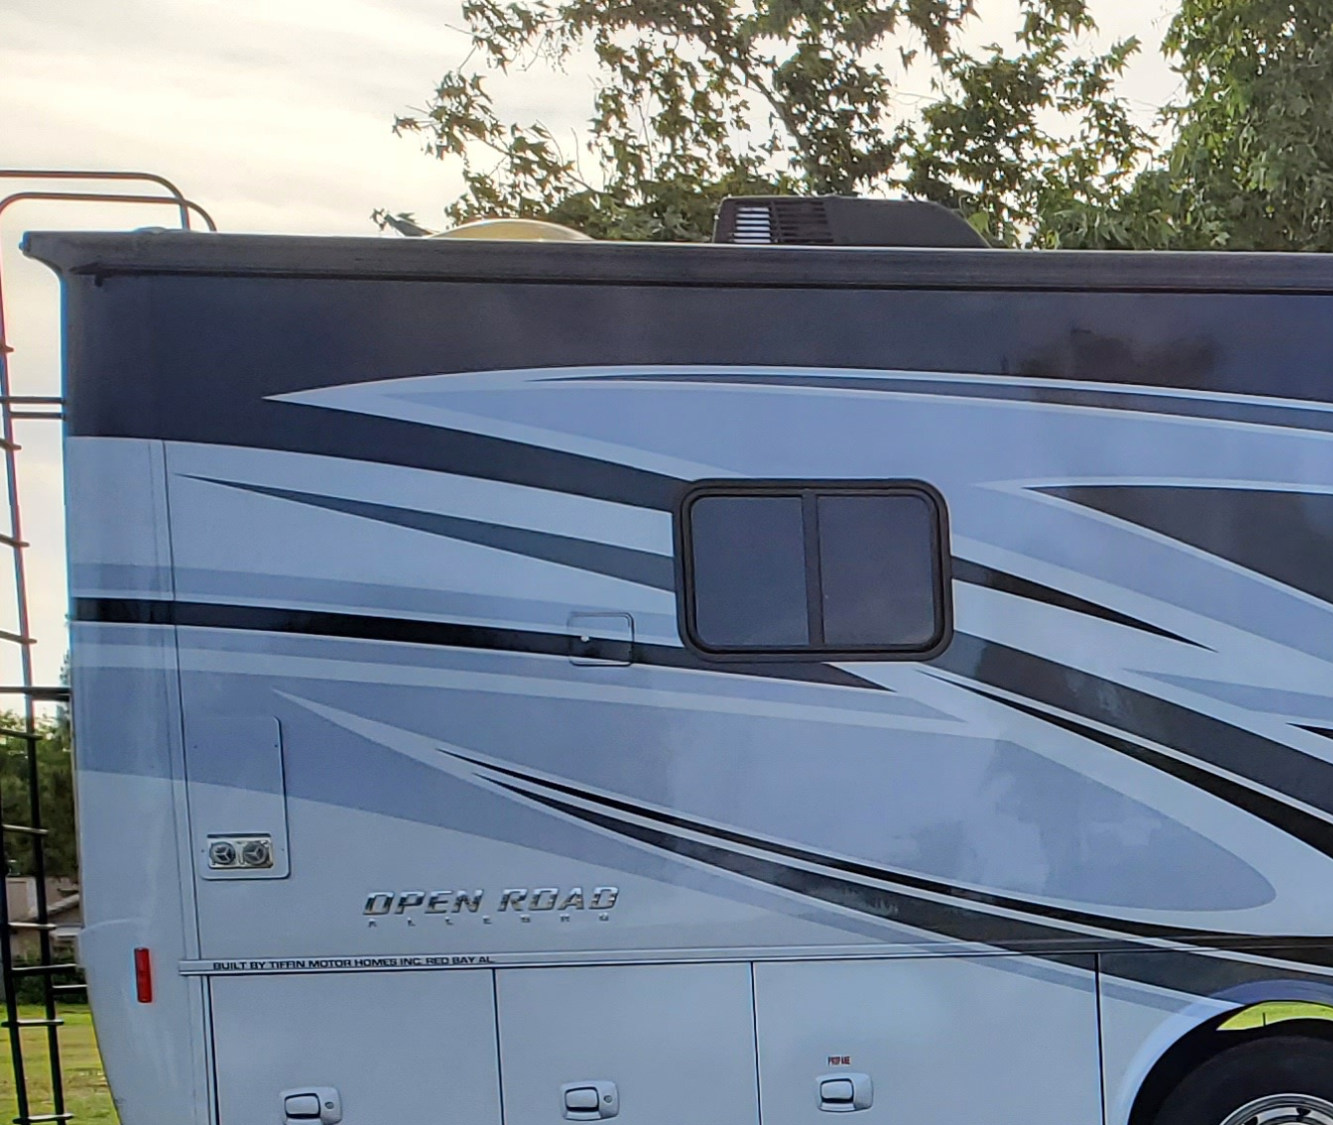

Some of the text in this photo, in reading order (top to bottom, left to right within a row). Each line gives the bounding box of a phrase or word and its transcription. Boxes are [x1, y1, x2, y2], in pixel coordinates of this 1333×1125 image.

[363, 886, 619, 915] OPEN ROAD
[213, 962, 246, 970] BUILT
[250, 961, 265, 970] BY
[269, 960, 305, 969] TIFFIN
[309, 959, 351, 968] MOTOR
[354, 958, 397, 967] HOMES
[425, 957, 448, 965] RED
[452, 956, 475, 965] BAY
